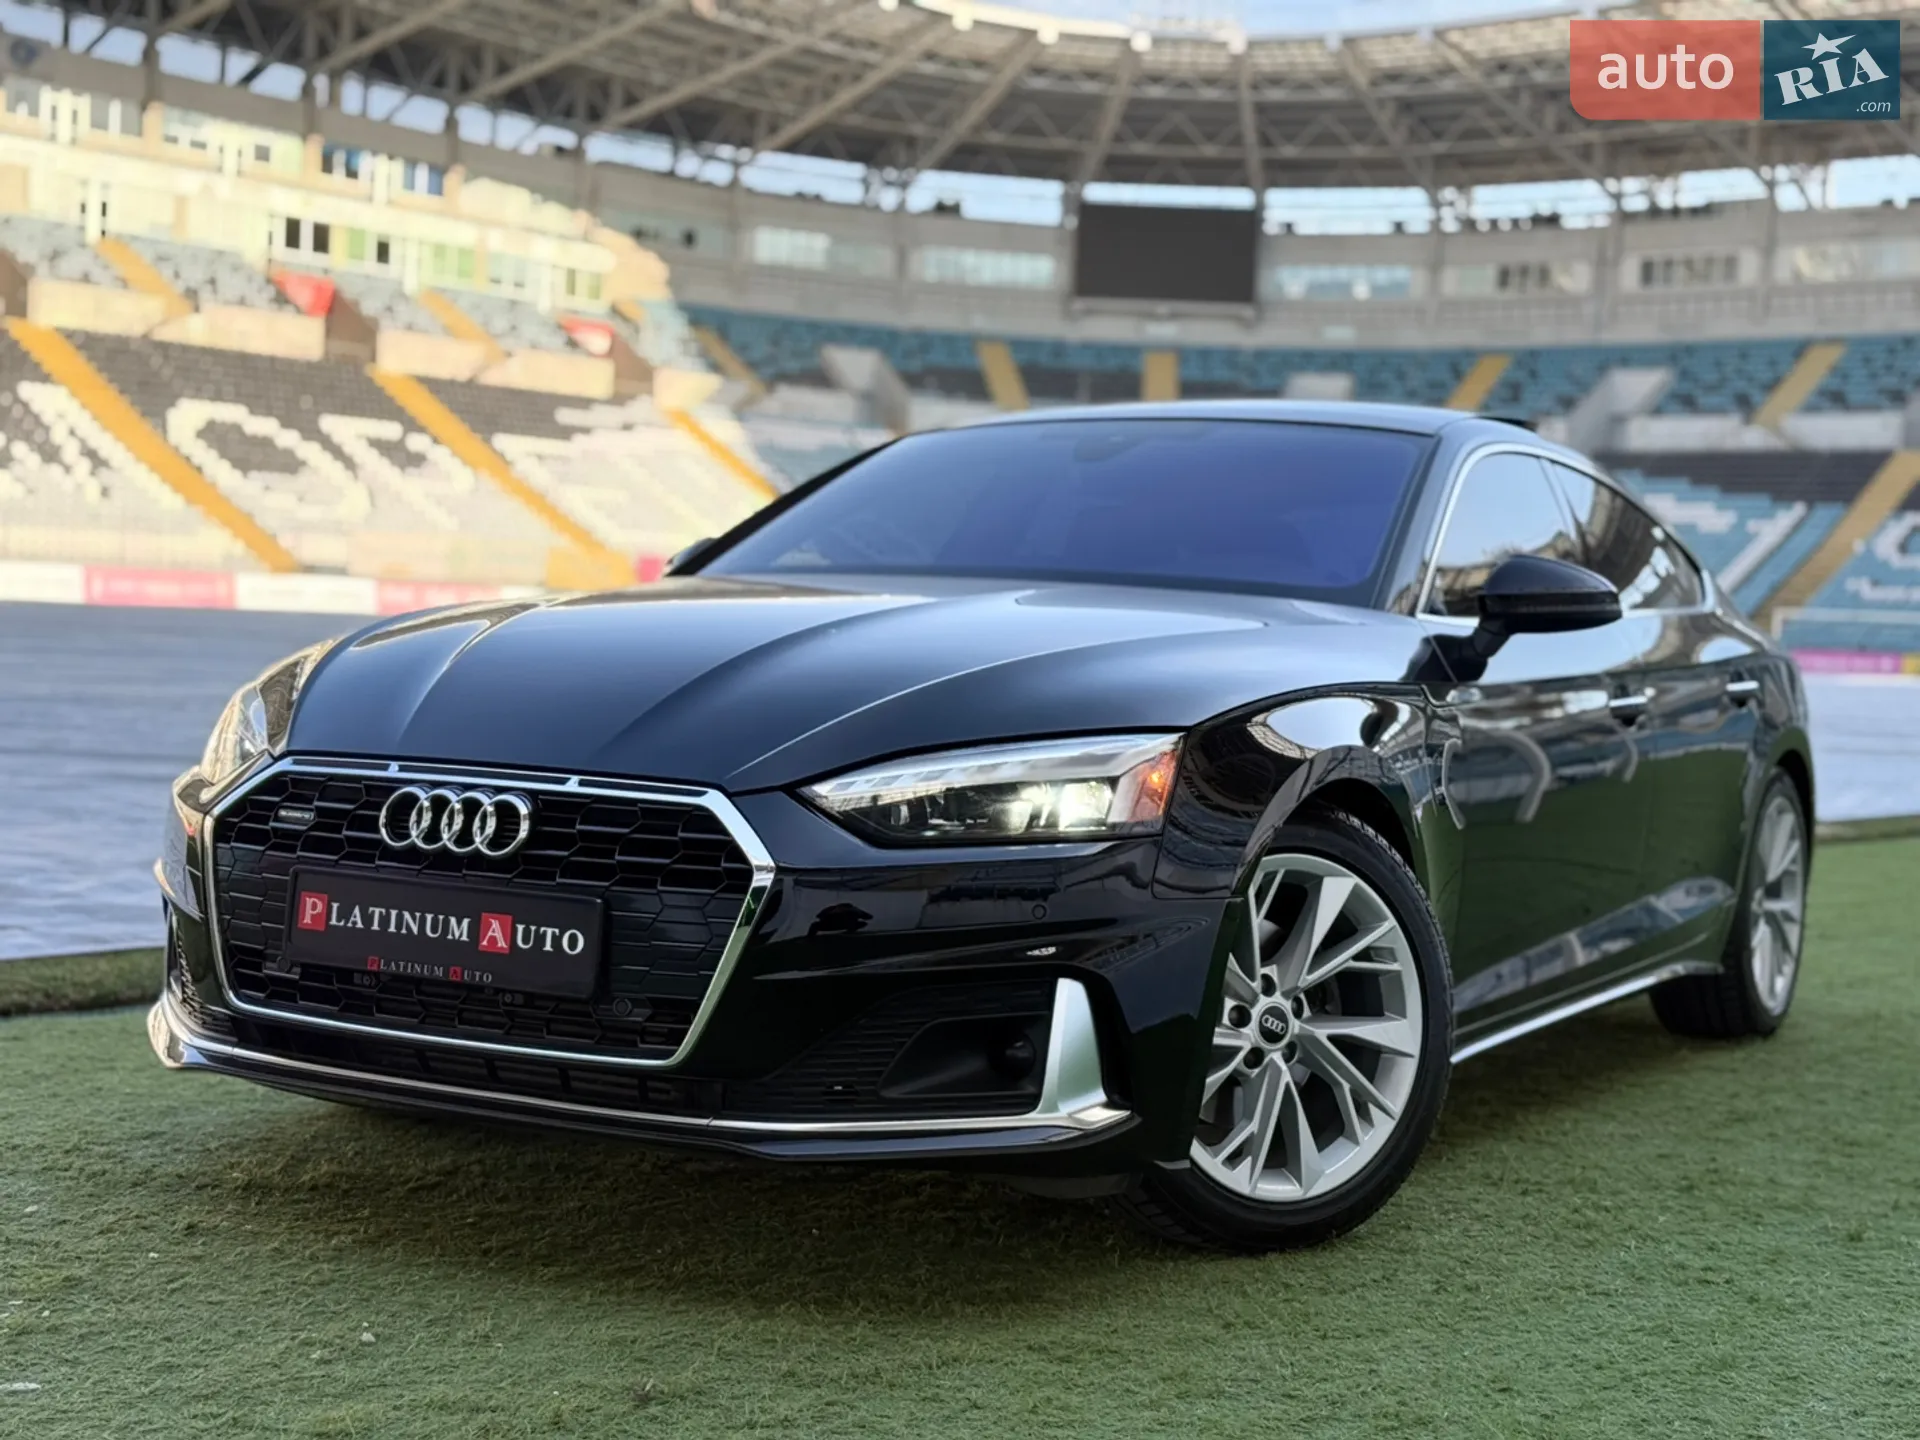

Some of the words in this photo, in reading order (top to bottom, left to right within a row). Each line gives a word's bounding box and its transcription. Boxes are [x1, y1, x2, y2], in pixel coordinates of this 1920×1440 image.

[300, 894, 472, 942] PLATINUM
[480, 917, 585, 955] AUTO
[368, 956, 444, 978] PLATINUM
[449, 966, 493, 984] AUTO
